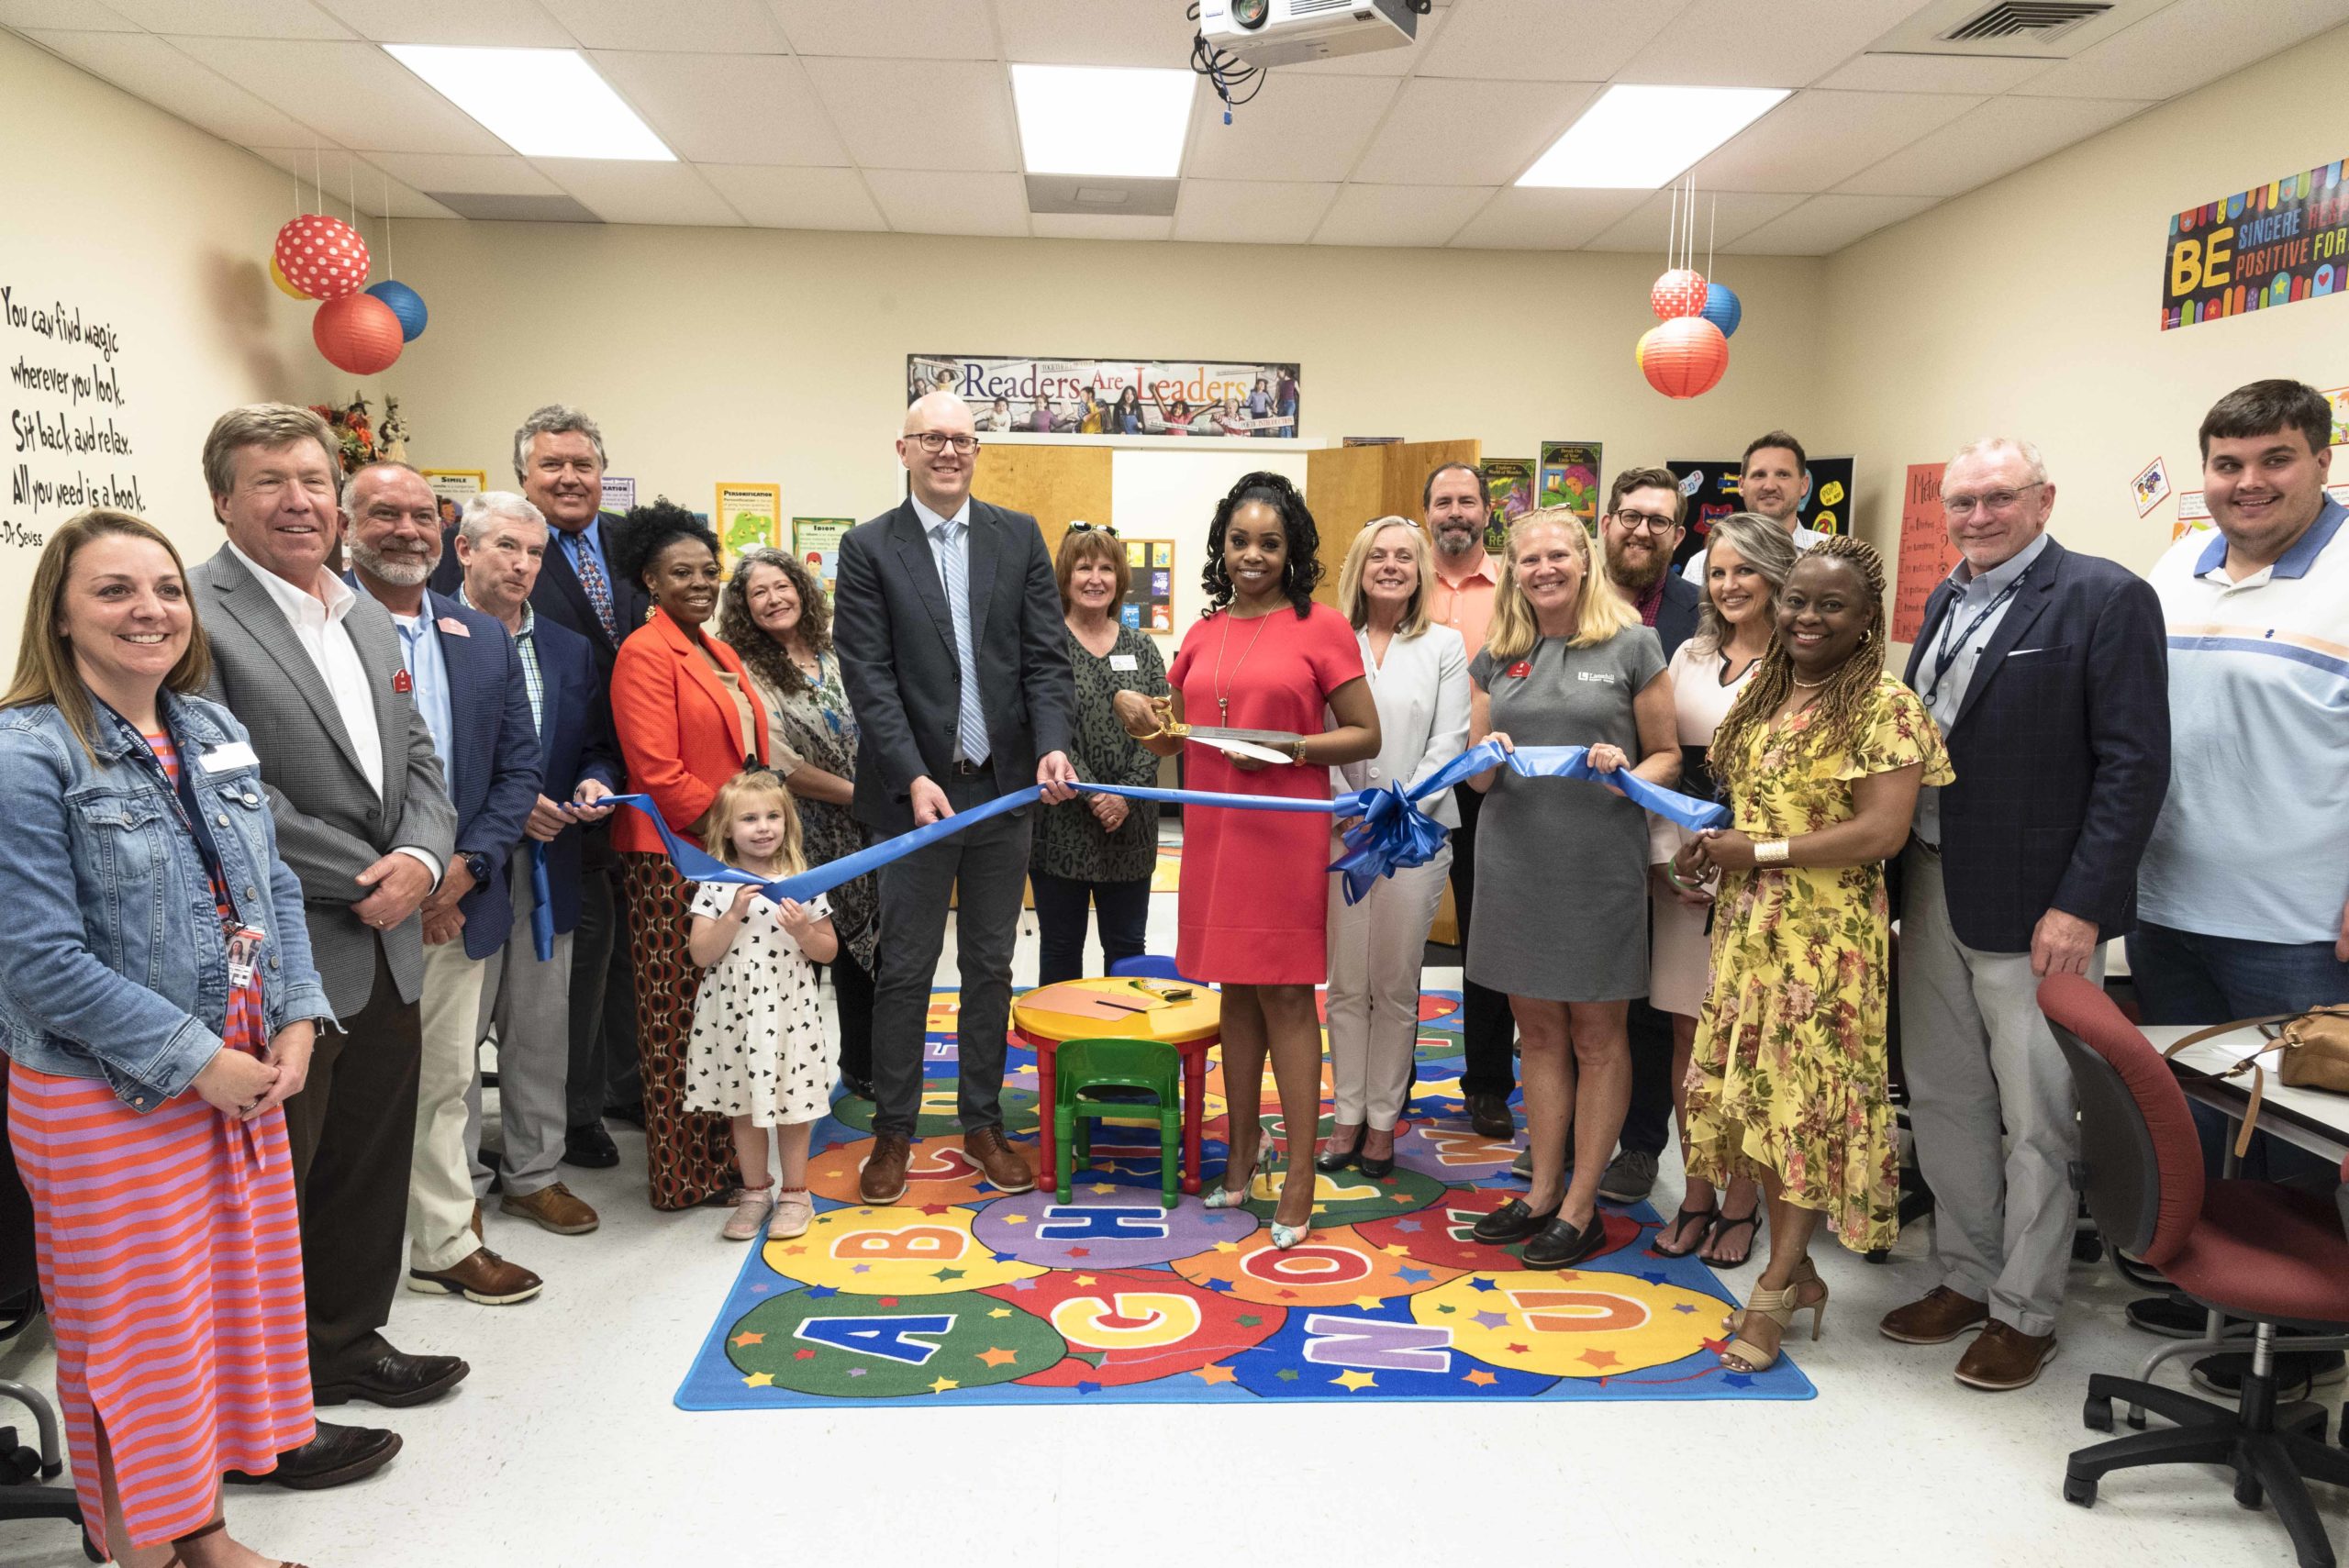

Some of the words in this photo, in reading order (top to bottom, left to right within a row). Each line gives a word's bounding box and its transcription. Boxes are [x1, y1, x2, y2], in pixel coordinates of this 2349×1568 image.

[2238, 208, 2302, 250] SINCERE
[2172, 227, 2234, 297] BE
[2235, 237, 2310, 282] POSITIVE
[2313, 228, 2349, 261] FOR
[1, 286, 28, 328] You
[31, 310, 54, 339] can
[55, 301, 82, 344] find
[84, 323, 119, 362] magic
[11, 355, 69, 394] wherever
[72, 373, 91, 406] you
[93, 363, 125, 409] look.
[963, 363, 1081, 399] Readers
[1092, 369, 1124, 390] Are
[1135, 366, 1246, 403] Leaders
[12, 409, 36, 452] Sit
[36, 410, 72, 456] back
[74, 416, 95, 455] and
[98, 417, 132, 455] relax.
[13, 463, 30, 505] All
[32, 480, 52, 514] you
[56, 471, 83, 508] need
[86, 478, 99, 508] is
[103, 486, 111, 507] a
[111, 473, 146, 515] book.
[17, 523, 43, 548] Seuss
[128, 728, 144, 746] ATHENS
[142, 742, 154, 757] STATE
[829, 1224, 970, 1262] B
[1035, 1205, 1169, 1240] H
[1240, 1244, 1373, 1285] O
[1050, 1292, 1201, 1350] G
[1505, 1288, 1652, 1333] U
[793, 1314, 959, 1366] A
[1303, 1313, 1453, 1373] N
